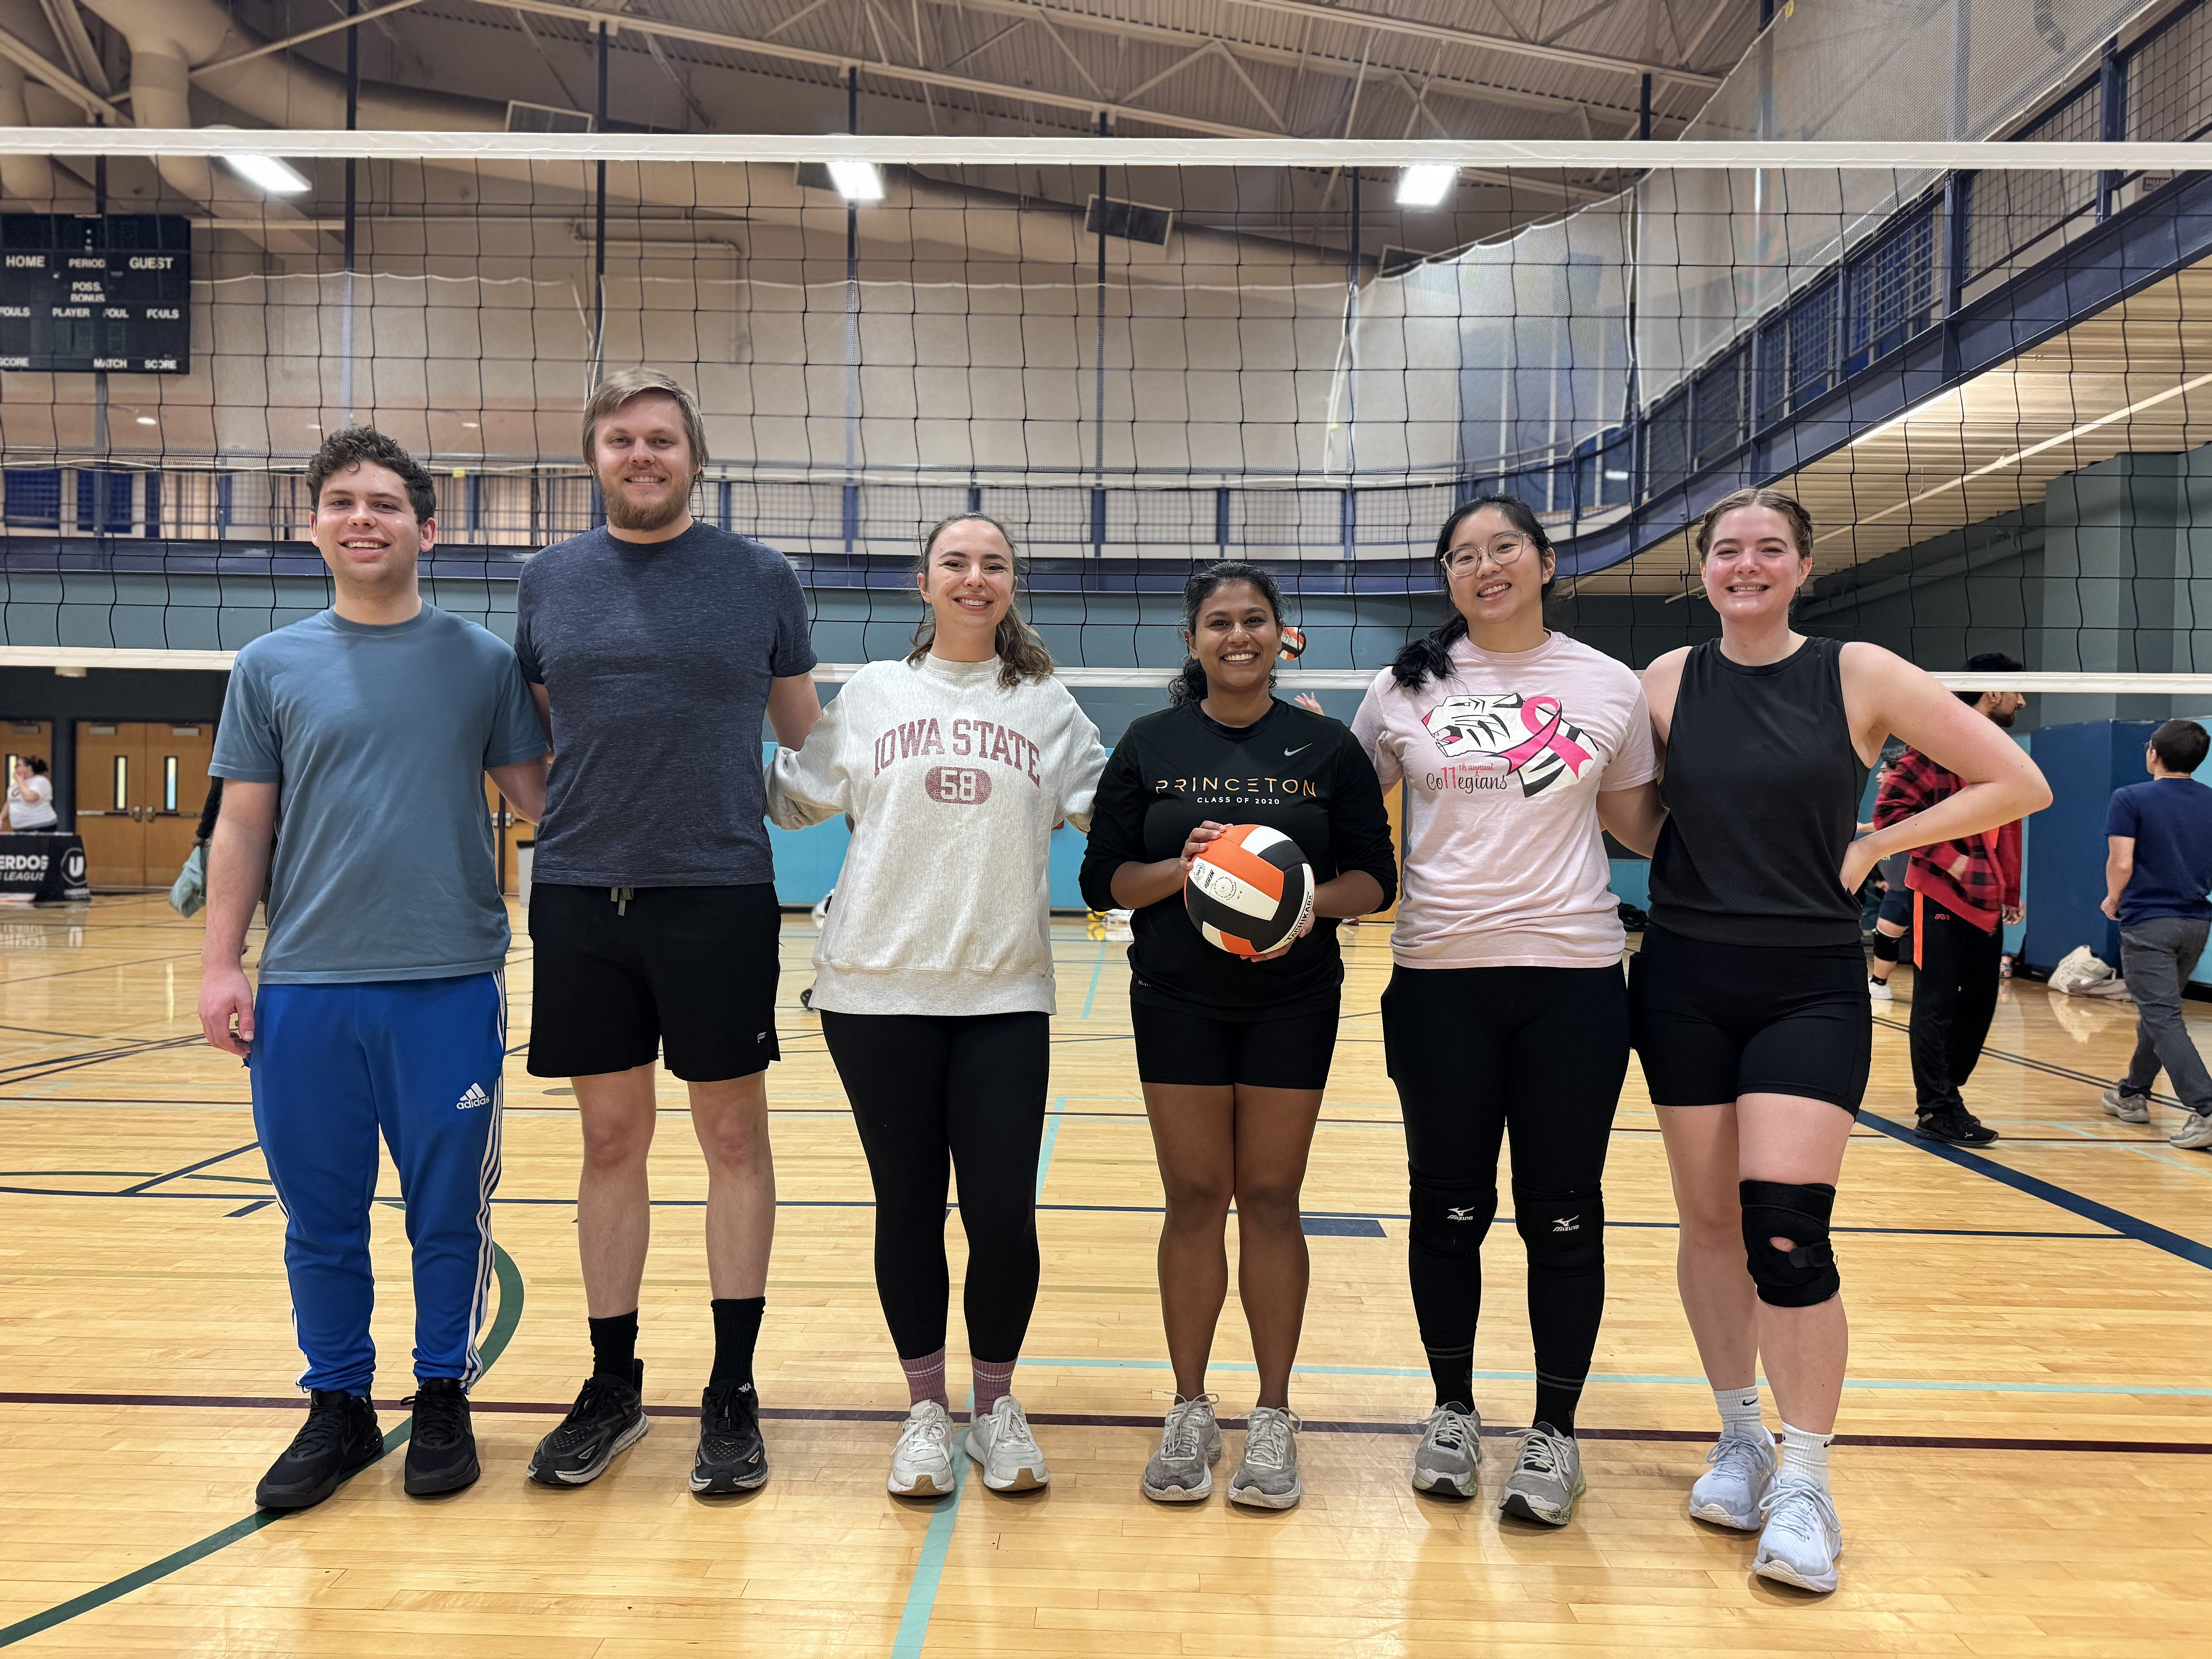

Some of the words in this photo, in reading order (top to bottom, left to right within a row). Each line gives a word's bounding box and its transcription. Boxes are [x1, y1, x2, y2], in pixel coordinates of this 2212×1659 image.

[6, 255, 45, 267] HOME
[68, 258, 106, 268] PERIOD
[129, 257, 173, 269] GUEST
[72, 281, 102, 291] POSS.
[70, 293, 105, 302] BONUS
[52, 307, 90, 317] PLAYER
[93, 359, 128, 368] MATCH
[874, 718, 945, 778] IOWA
[952, 718, 1041, 788] STATE
[941, 769, 976, 801] 58
[1155, 777, 1317, 797] PRINCETON
[456, 1096, 489, 1110] adidas
